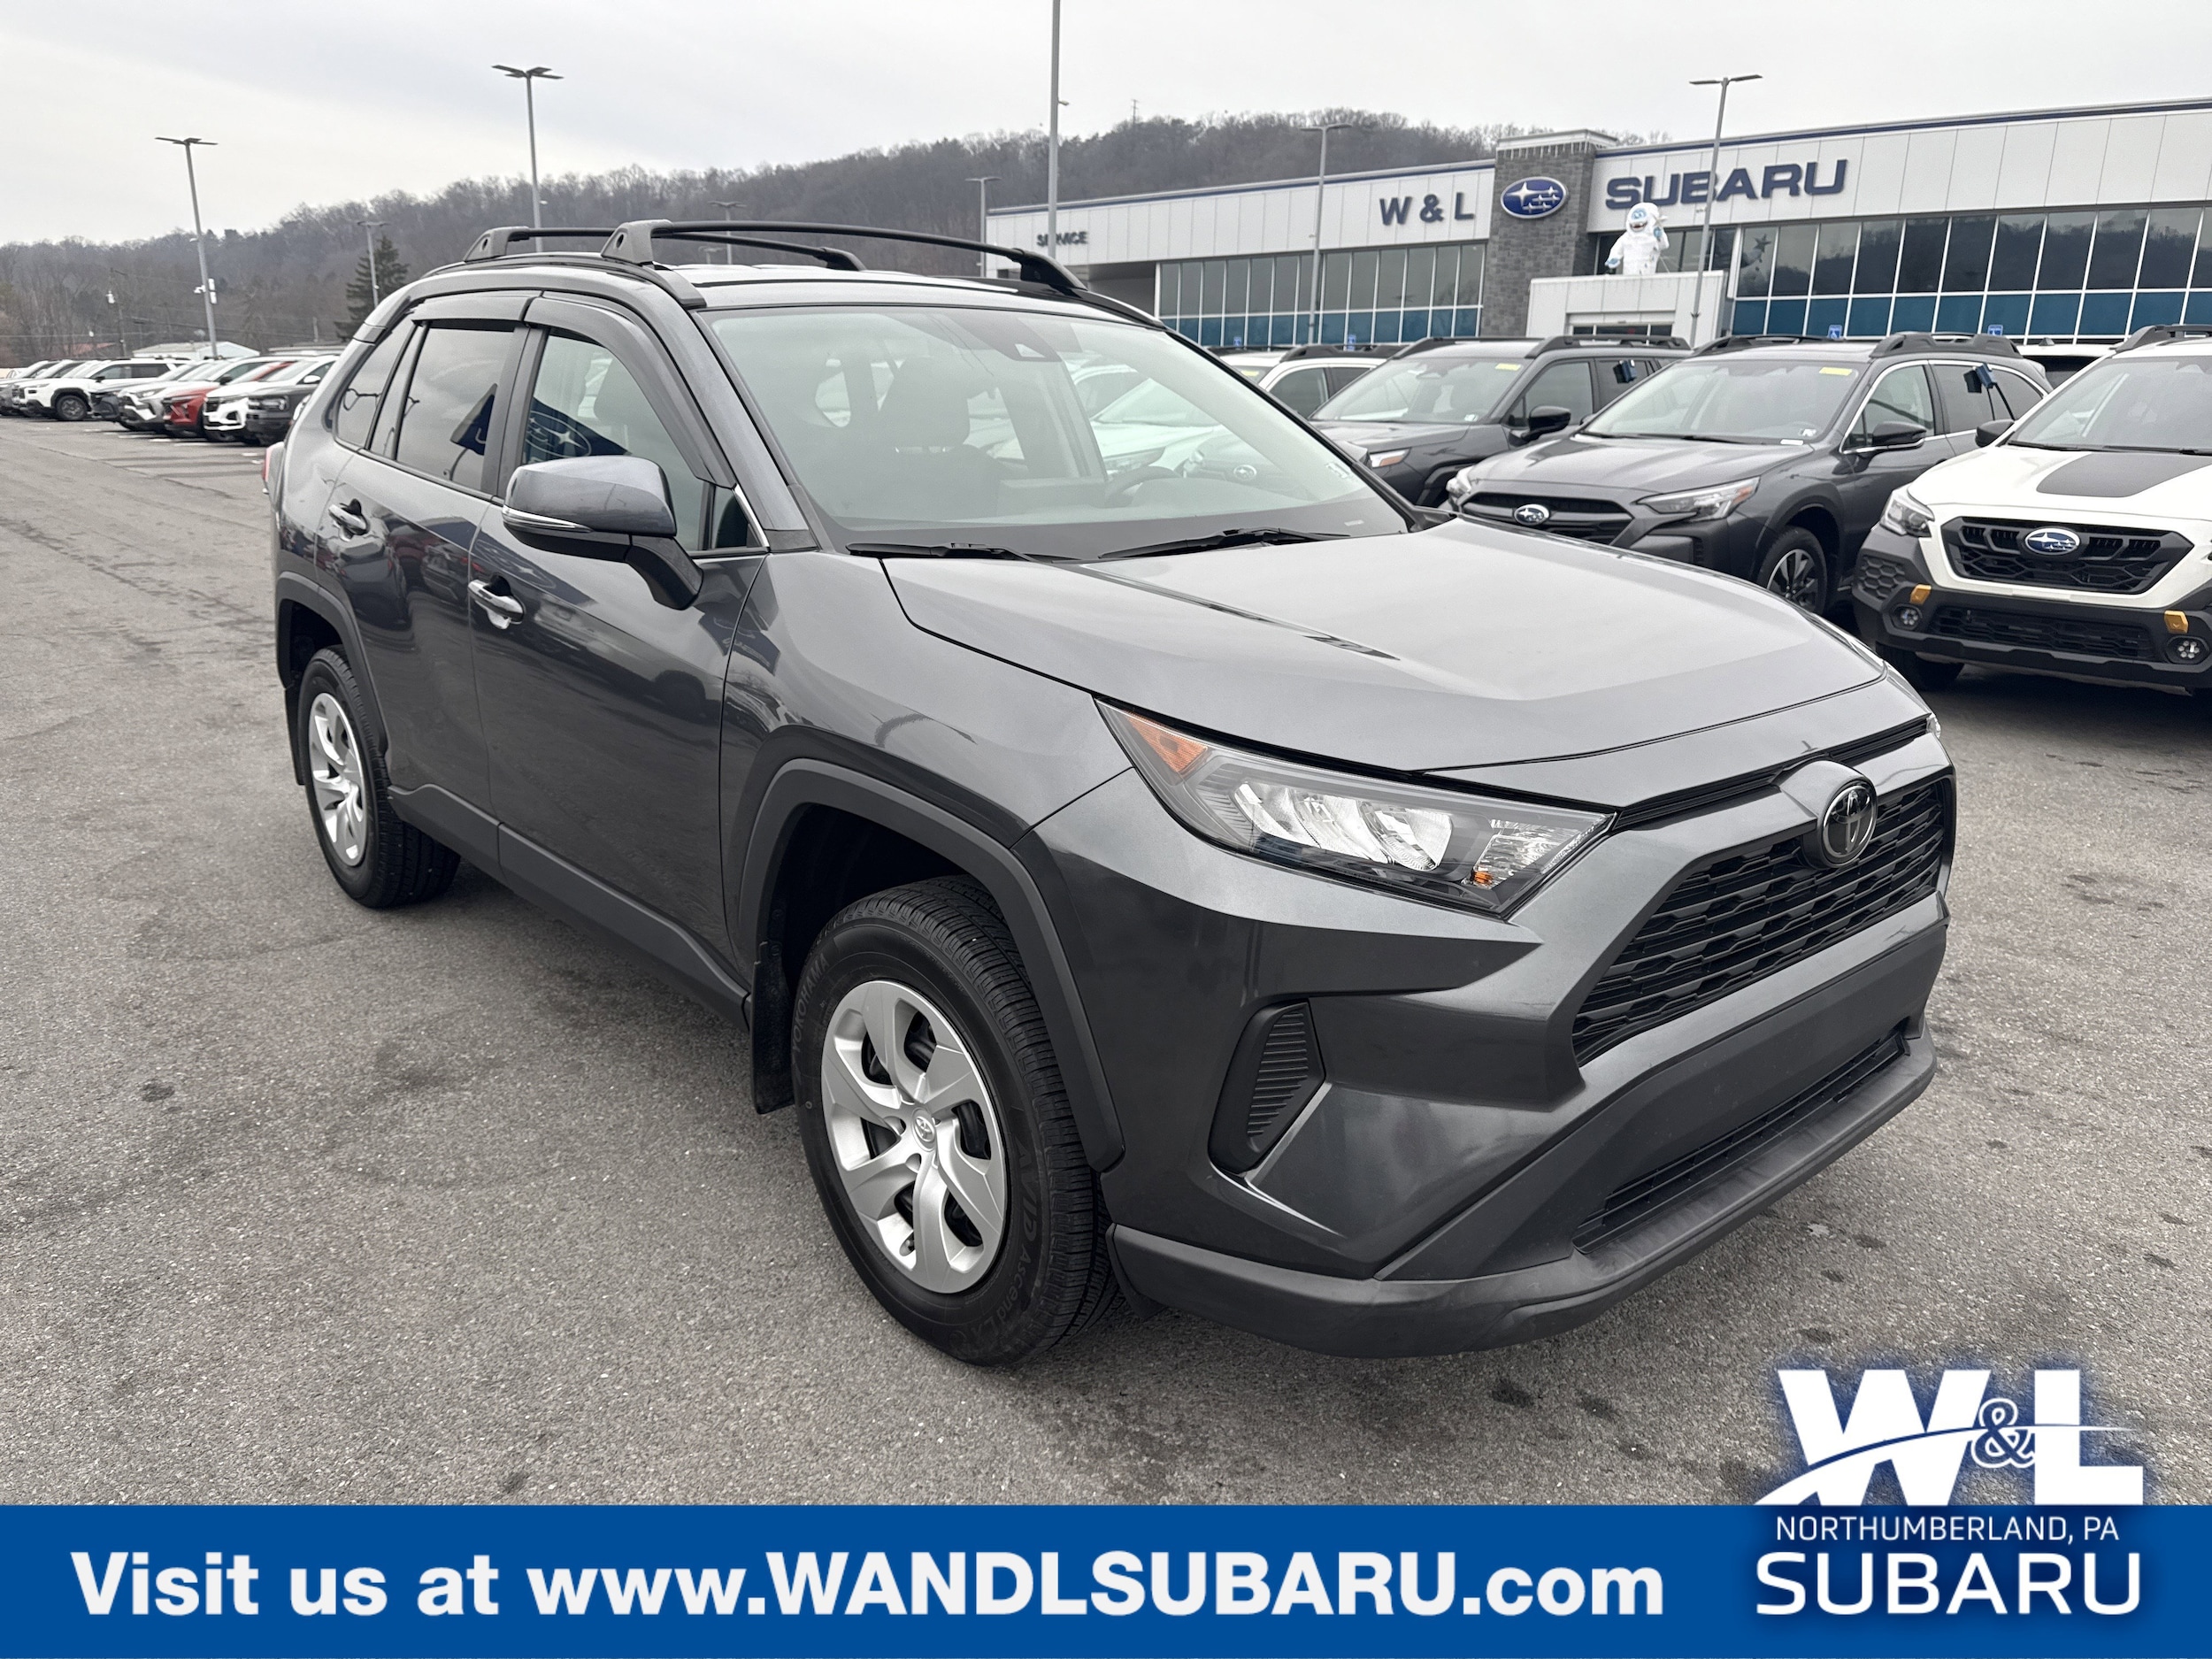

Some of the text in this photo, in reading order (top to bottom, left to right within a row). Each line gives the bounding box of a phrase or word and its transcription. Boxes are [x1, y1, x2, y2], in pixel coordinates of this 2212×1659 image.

[1379, 191, 1475, 226] W & L
[1605, 158, 1848, 211] SUBARU
[792, 952, 831, 1054] YOKOHAMA
[1014, 1135, 1038, 1242] AVID
